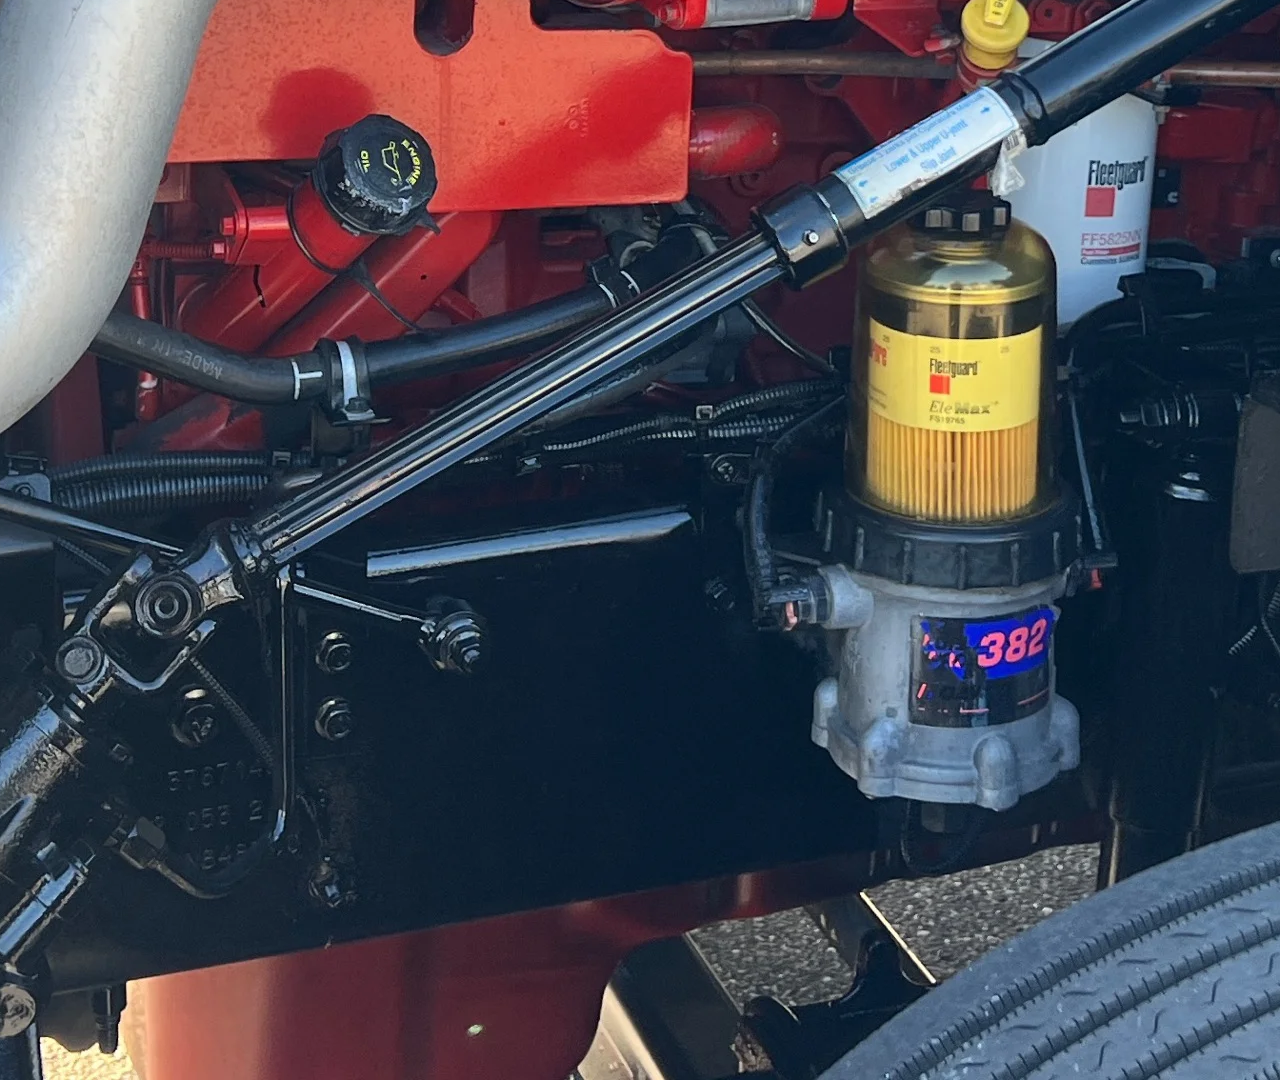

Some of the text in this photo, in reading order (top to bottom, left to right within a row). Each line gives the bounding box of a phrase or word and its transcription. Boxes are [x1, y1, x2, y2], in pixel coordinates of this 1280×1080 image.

[360, 150, 370, 173] OIL
[401, 139, 421, 185] ENGINE
[884, 153, 910, 172] Lower
[917, 134, 942, 153] Upper
[920, 157, 938, 172] Slip
[1087, 159, 1146, 190] Fleetguard
[181, 350, 223, 379] MADE
[930, 358, 978, 379] Fleetguard
[978, 618, 1048, 667] 382
